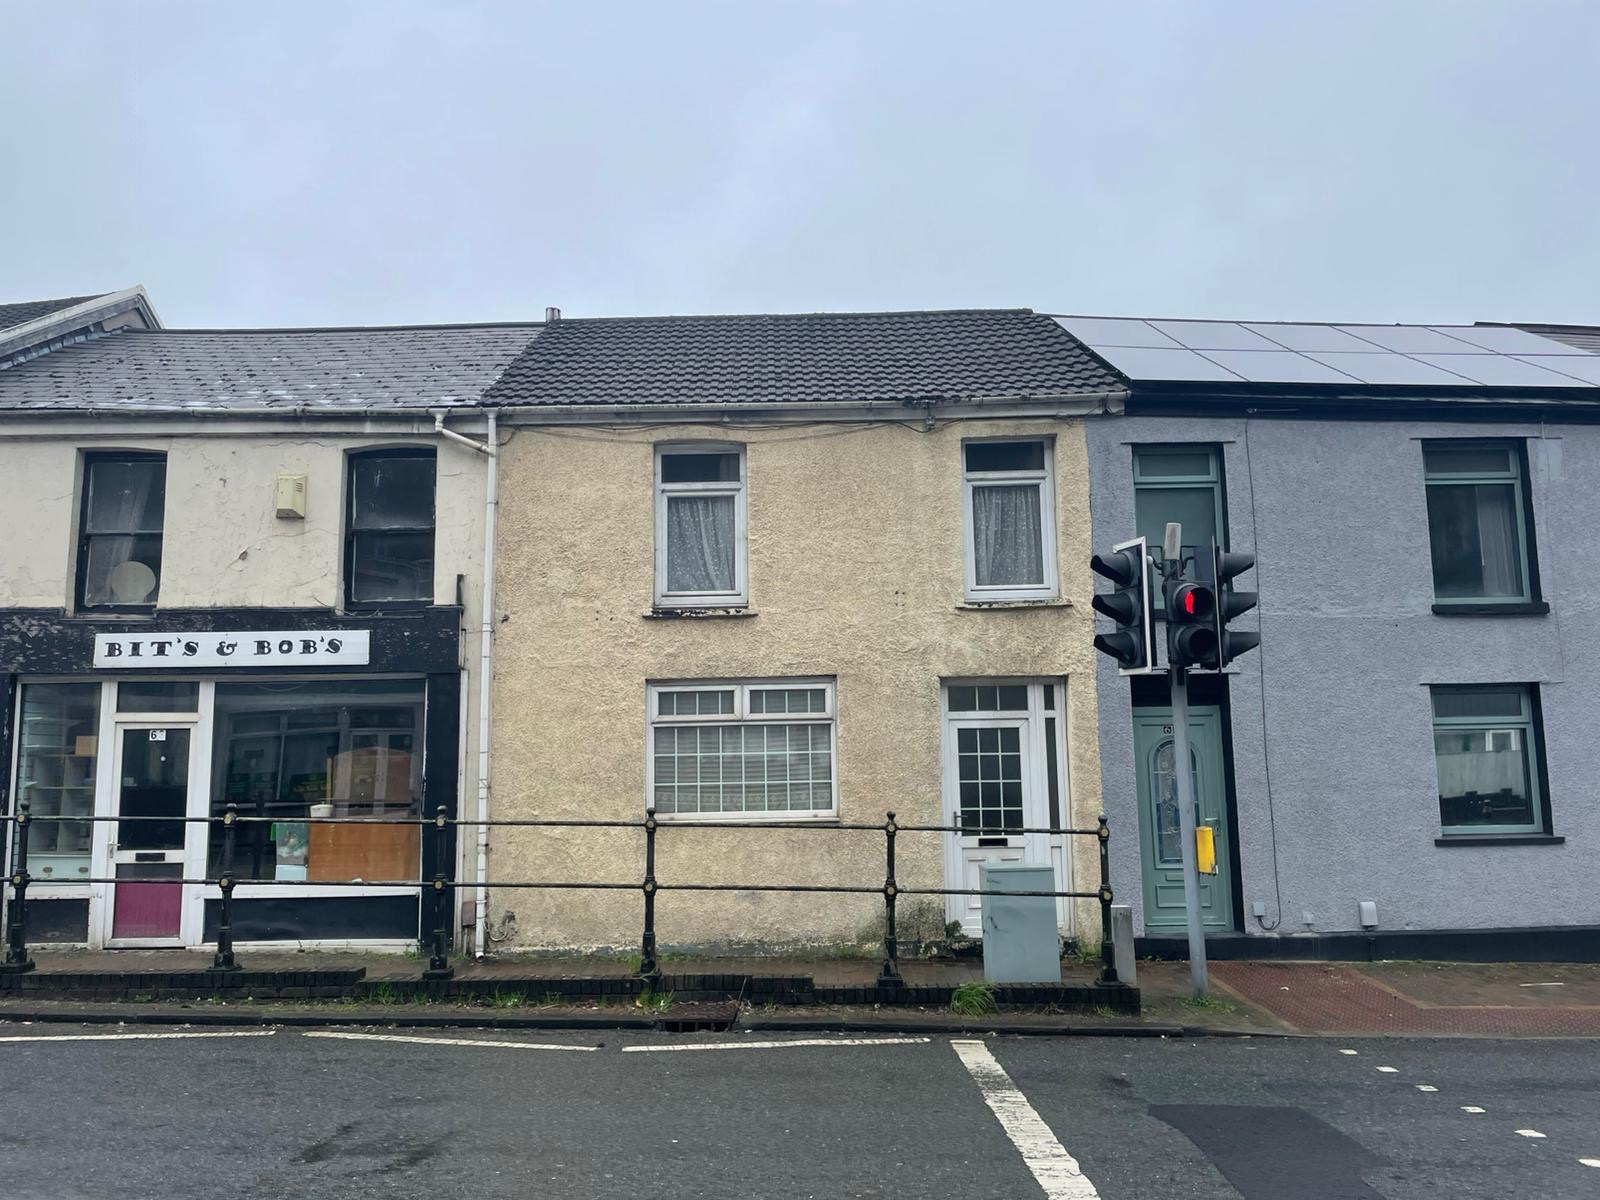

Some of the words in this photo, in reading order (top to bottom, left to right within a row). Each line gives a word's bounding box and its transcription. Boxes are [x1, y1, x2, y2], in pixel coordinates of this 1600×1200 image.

[104, 636, 199, 658] BIT'S
[216, 641, 238, 656] &
[253, 636, 343, 656] BOB'S
